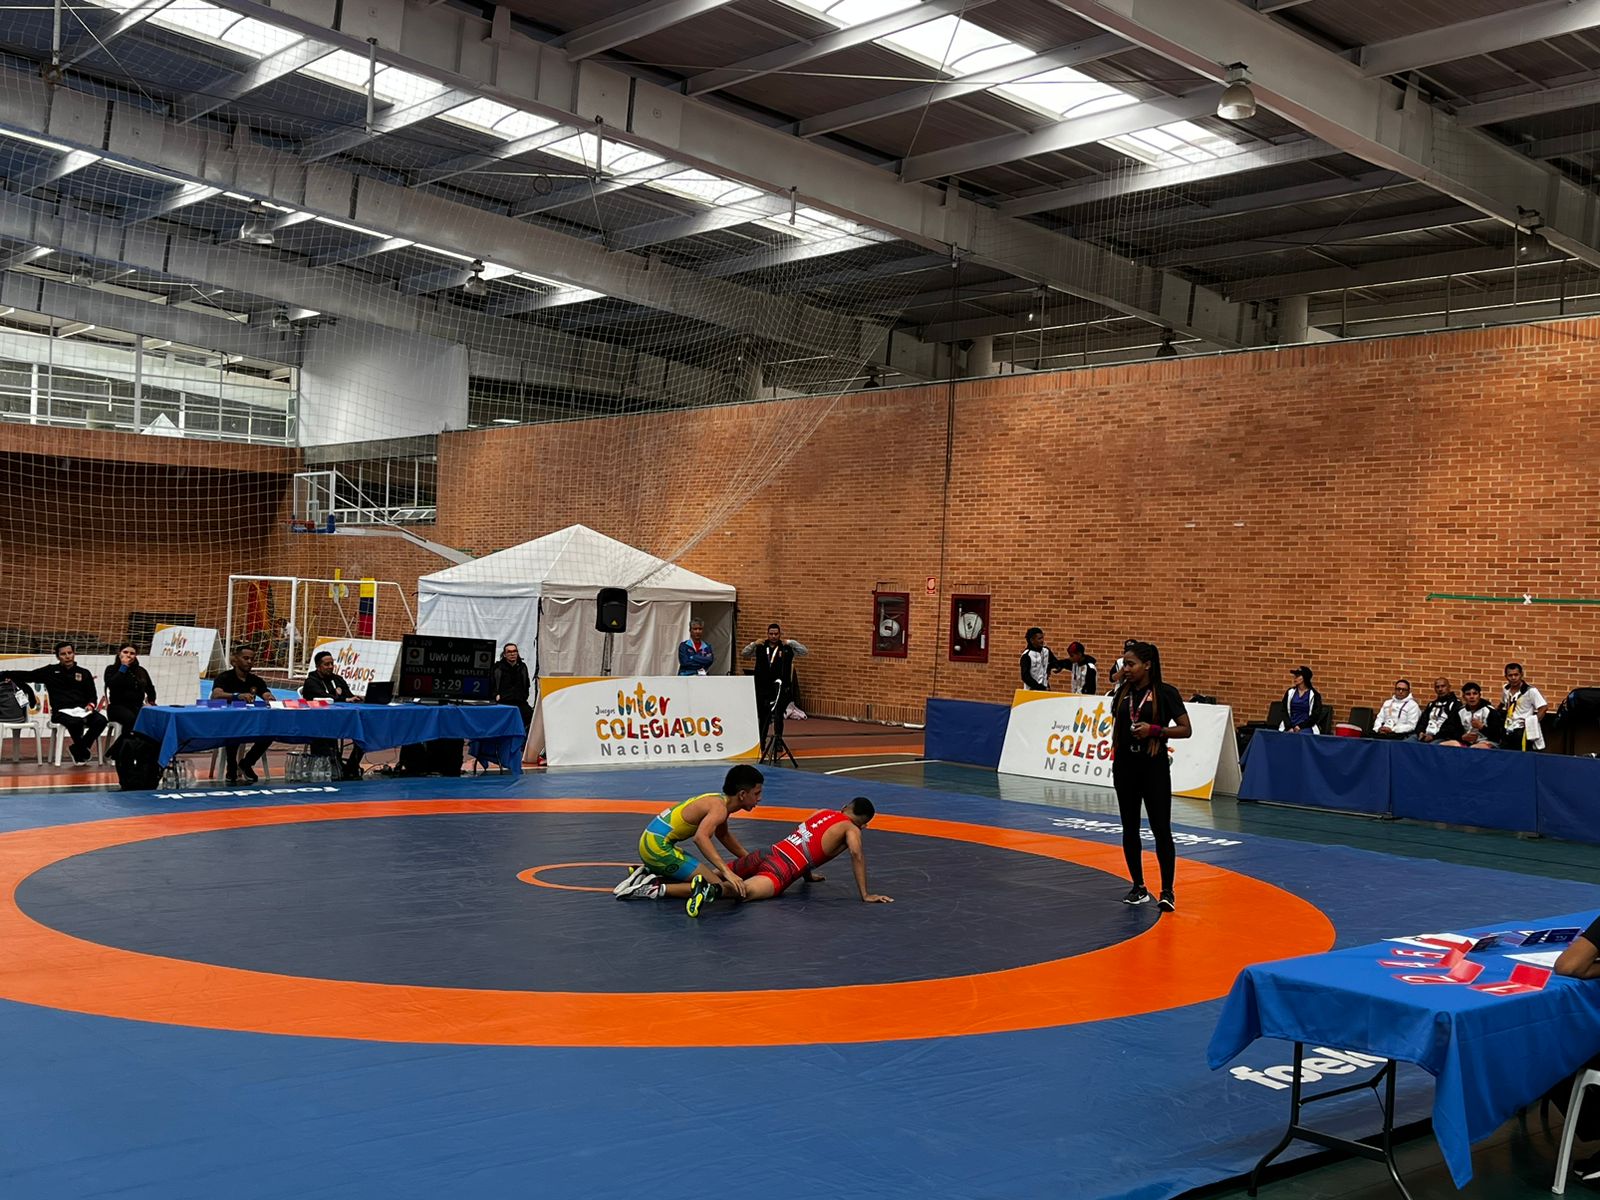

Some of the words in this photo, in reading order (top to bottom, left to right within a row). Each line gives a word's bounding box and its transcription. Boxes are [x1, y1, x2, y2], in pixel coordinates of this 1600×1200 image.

[414, 678, 421, 690] 0
[434, 678, 462, 691] 3:29
[473, 680, 481, 693] 2
[617, 682, 670, 719] Inter
[1073, 701, 1115, 739] Inte
[595, 717, 723, 740] COLEGIADOS
[600, 740, 724, 756] Nacionales
